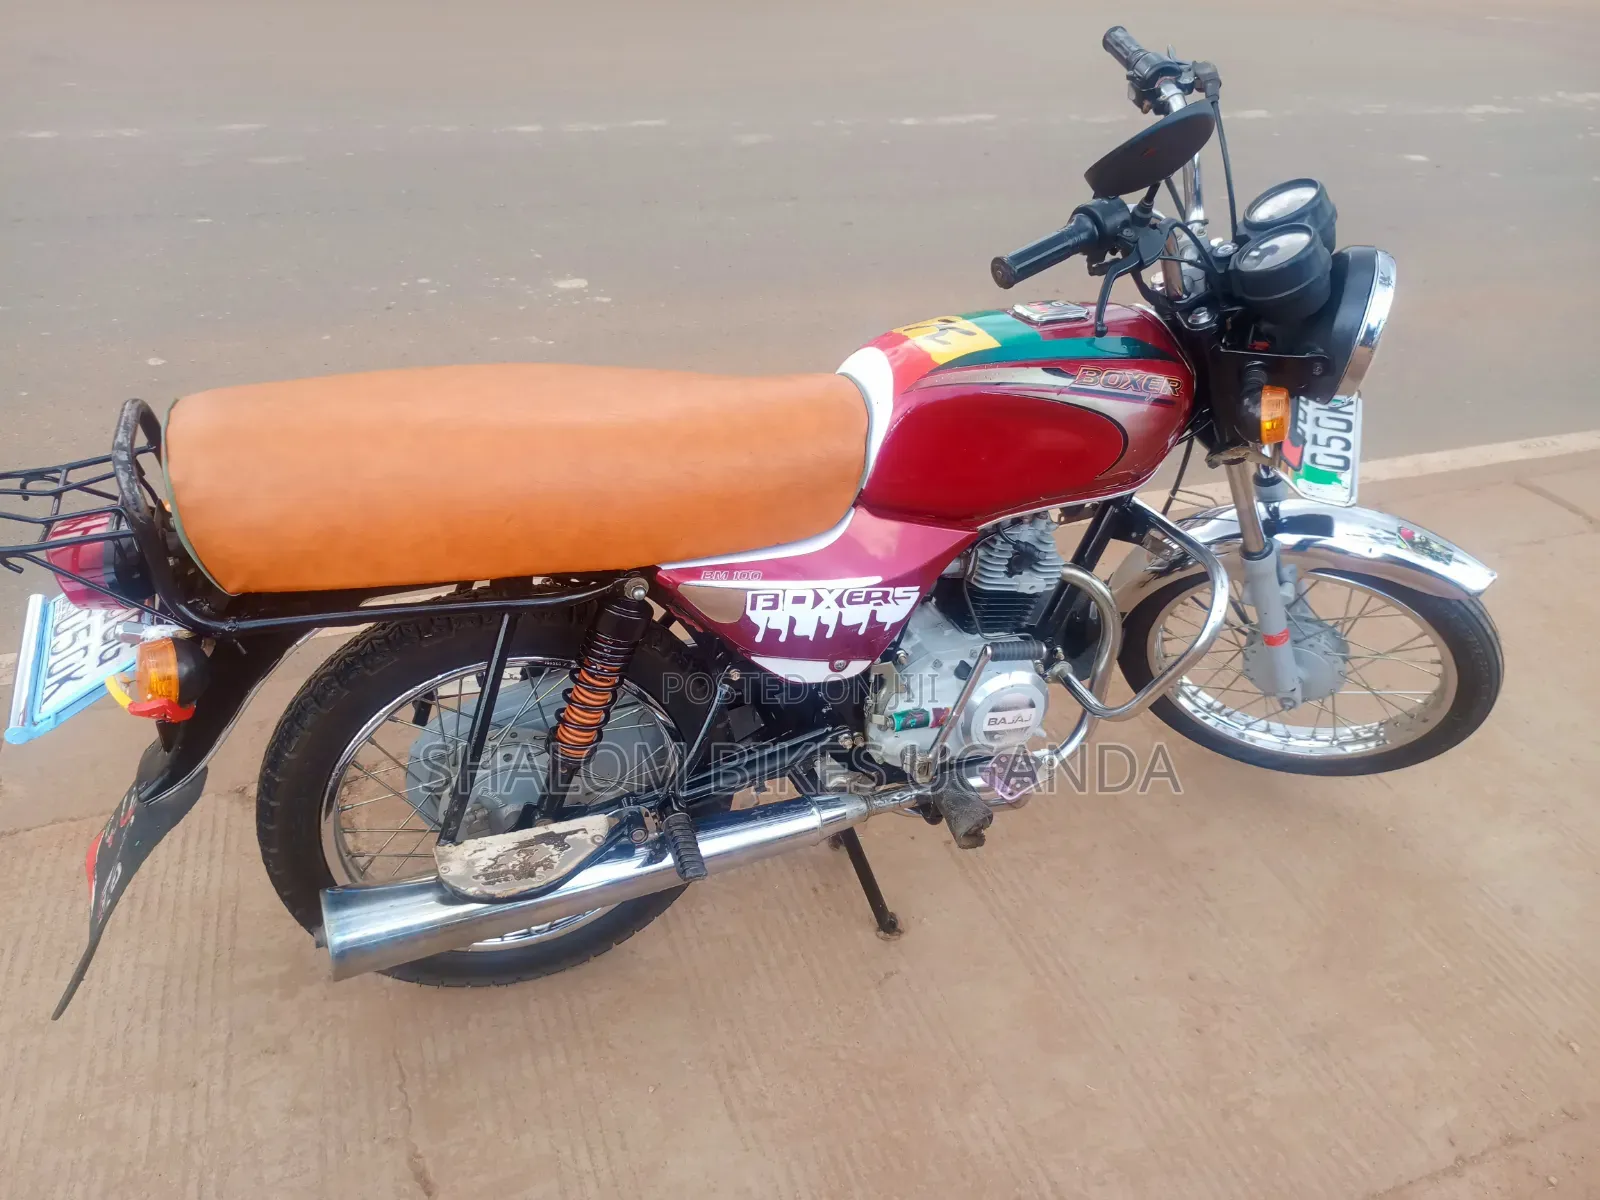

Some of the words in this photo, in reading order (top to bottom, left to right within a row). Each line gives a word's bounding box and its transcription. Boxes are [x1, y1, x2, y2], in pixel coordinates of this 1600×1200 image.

[1074, 365, 1183, 397] BOXER
[700, 570, 730, 581] BM
[732, 570, 763, 581] 100
[746, 586, 920, 617] BOXERS
[986, 713, 1033, 727] BAJAJ
